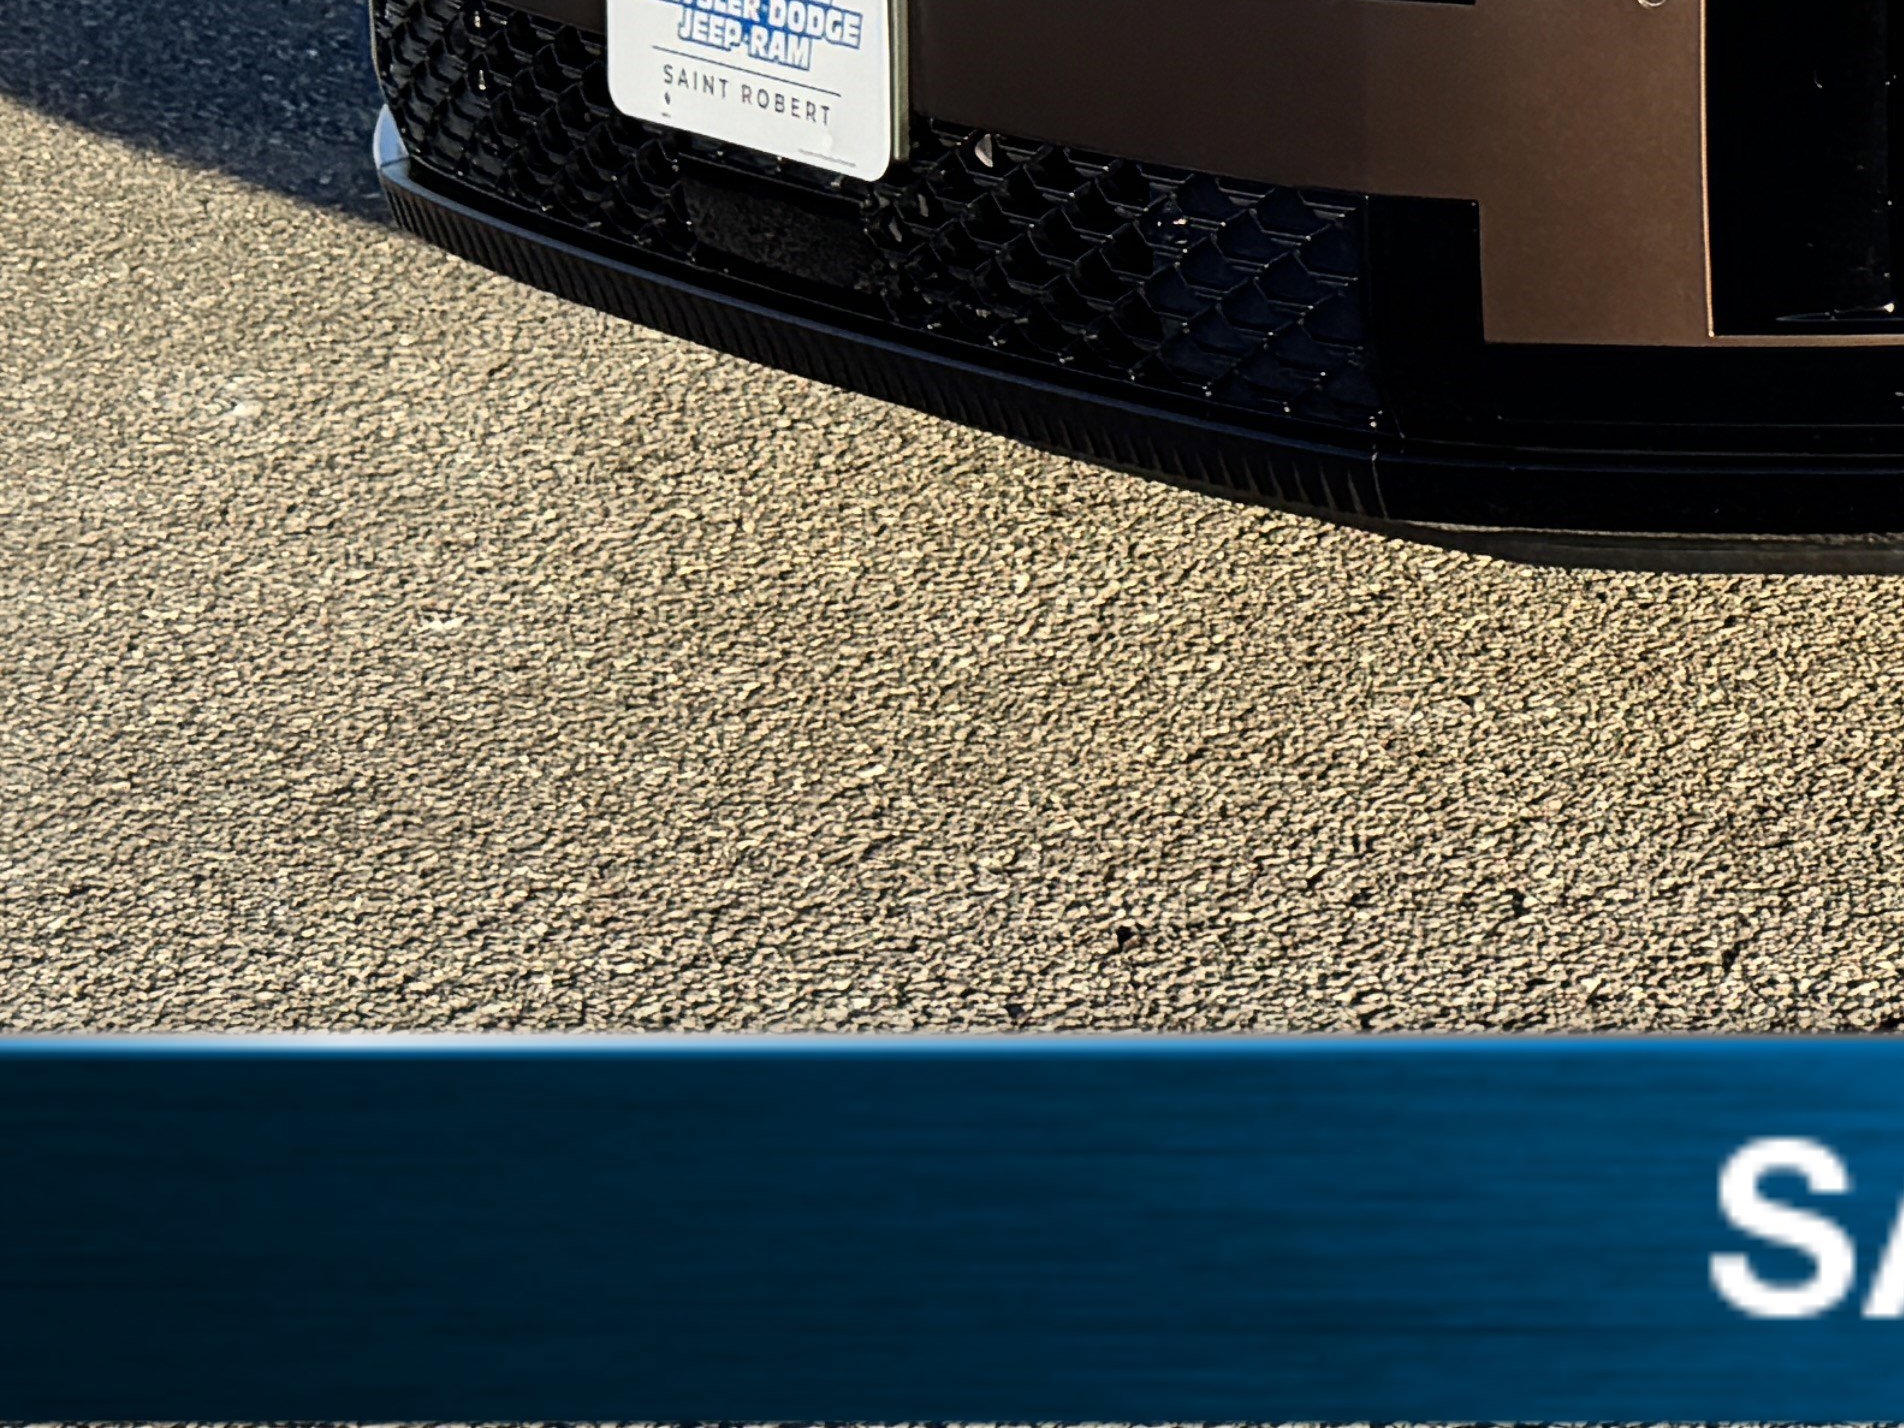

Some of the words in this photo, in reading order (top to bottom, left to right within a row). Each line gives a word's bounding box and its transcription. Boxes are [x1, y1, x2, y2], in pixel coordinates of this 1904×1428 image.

[678, 5, 743, 50] JEEP
[747, 23, 813, 71] RAM
[662, 64, 729, 101] SAINT
[741, 84, 831, 126] ROBERT
